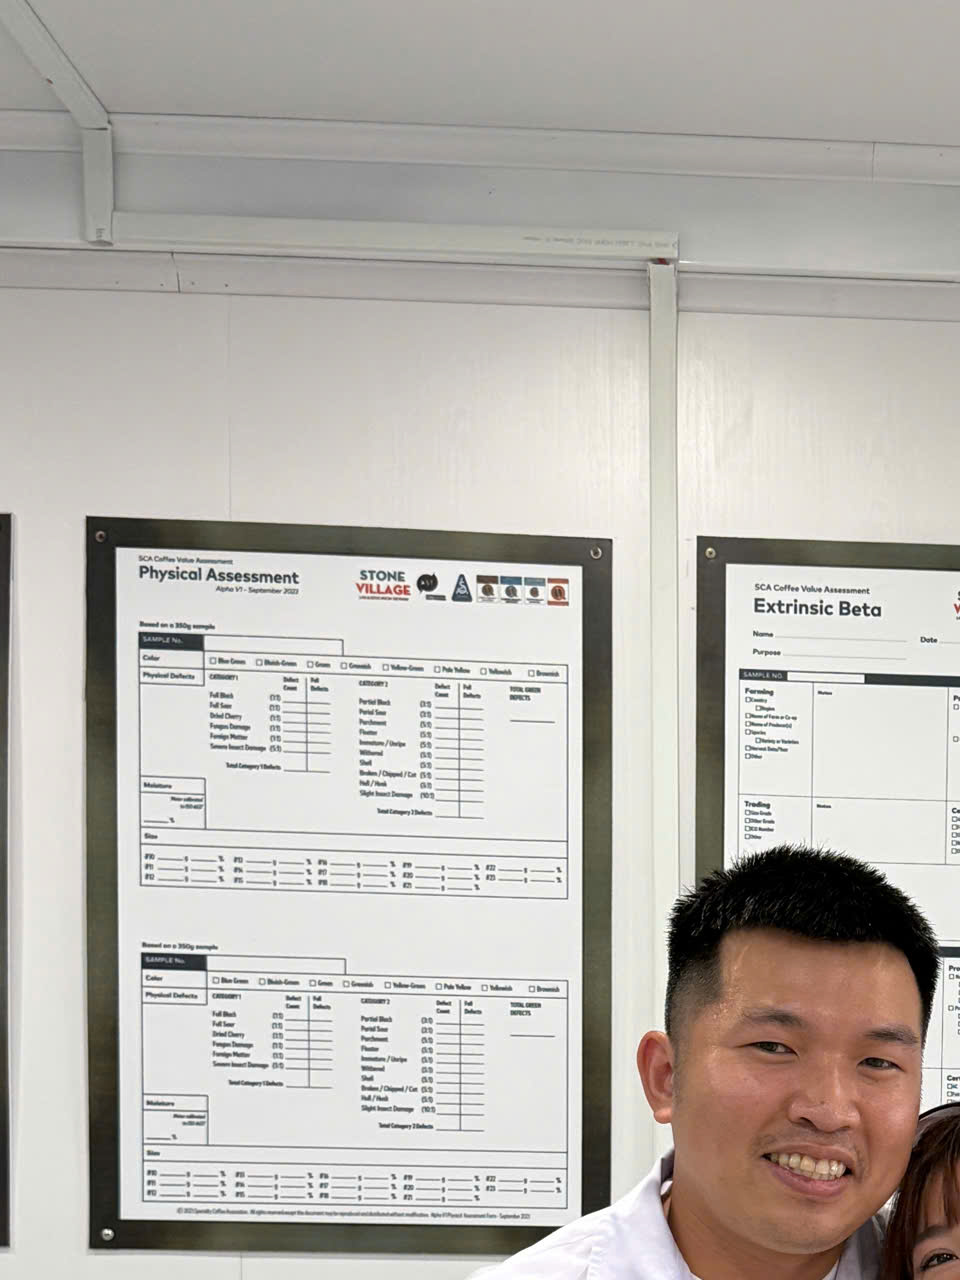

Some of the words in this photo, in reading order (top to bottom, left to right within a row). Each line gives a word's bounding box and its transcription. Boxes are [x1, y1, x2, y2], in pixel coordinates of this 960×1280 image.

[139, 566, 201, 582] Physical
[206, 568, 299, 584] Assessment
[360, 570, 405, 581] STONE
[356, 583, 410, 596] VILLAGE
[774, 584, 799, 593] Coffee
[801, 585, 822, 593] Value
[754, 598, 833, 616] Extrinsic
[839, 601, 882, 617] Beta
[143, 672, 169, 680] Physical
[745, 688, 773, 696] Farming
[745, 801, 770, 809] Trading
[146, 992, 171, 1000] Physical
